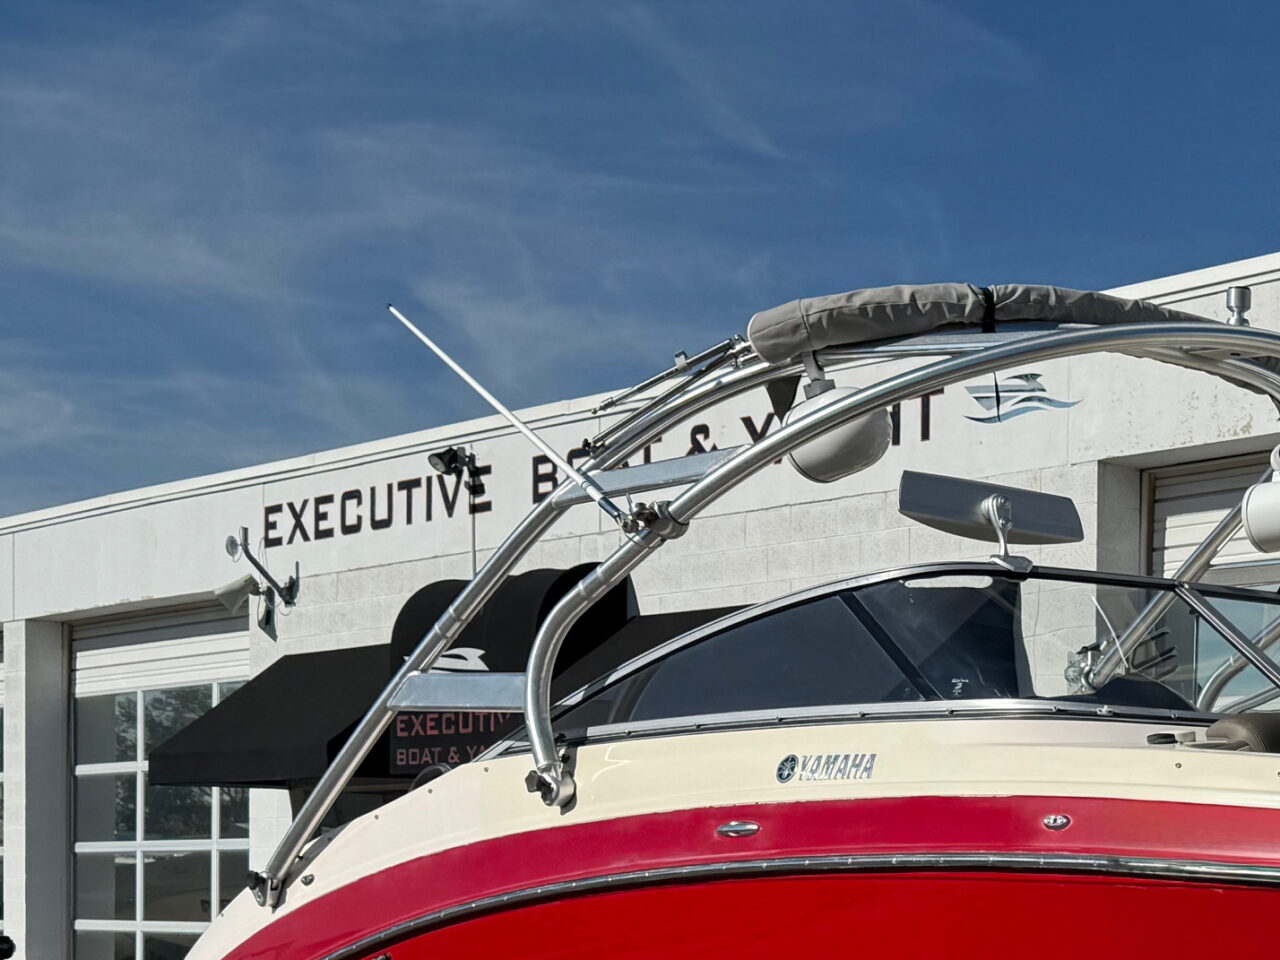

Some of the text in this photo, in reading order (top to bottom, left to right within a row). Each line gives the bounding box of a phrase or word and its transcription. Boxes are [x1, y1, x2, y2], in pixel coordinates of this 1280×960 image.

[263, 463, 493, 549] EXECUTIVE
[396, 747, 442, 766] BOAT
[447, 746, 461, 764] &
[798, 753, 877, 781] YAMAHA
